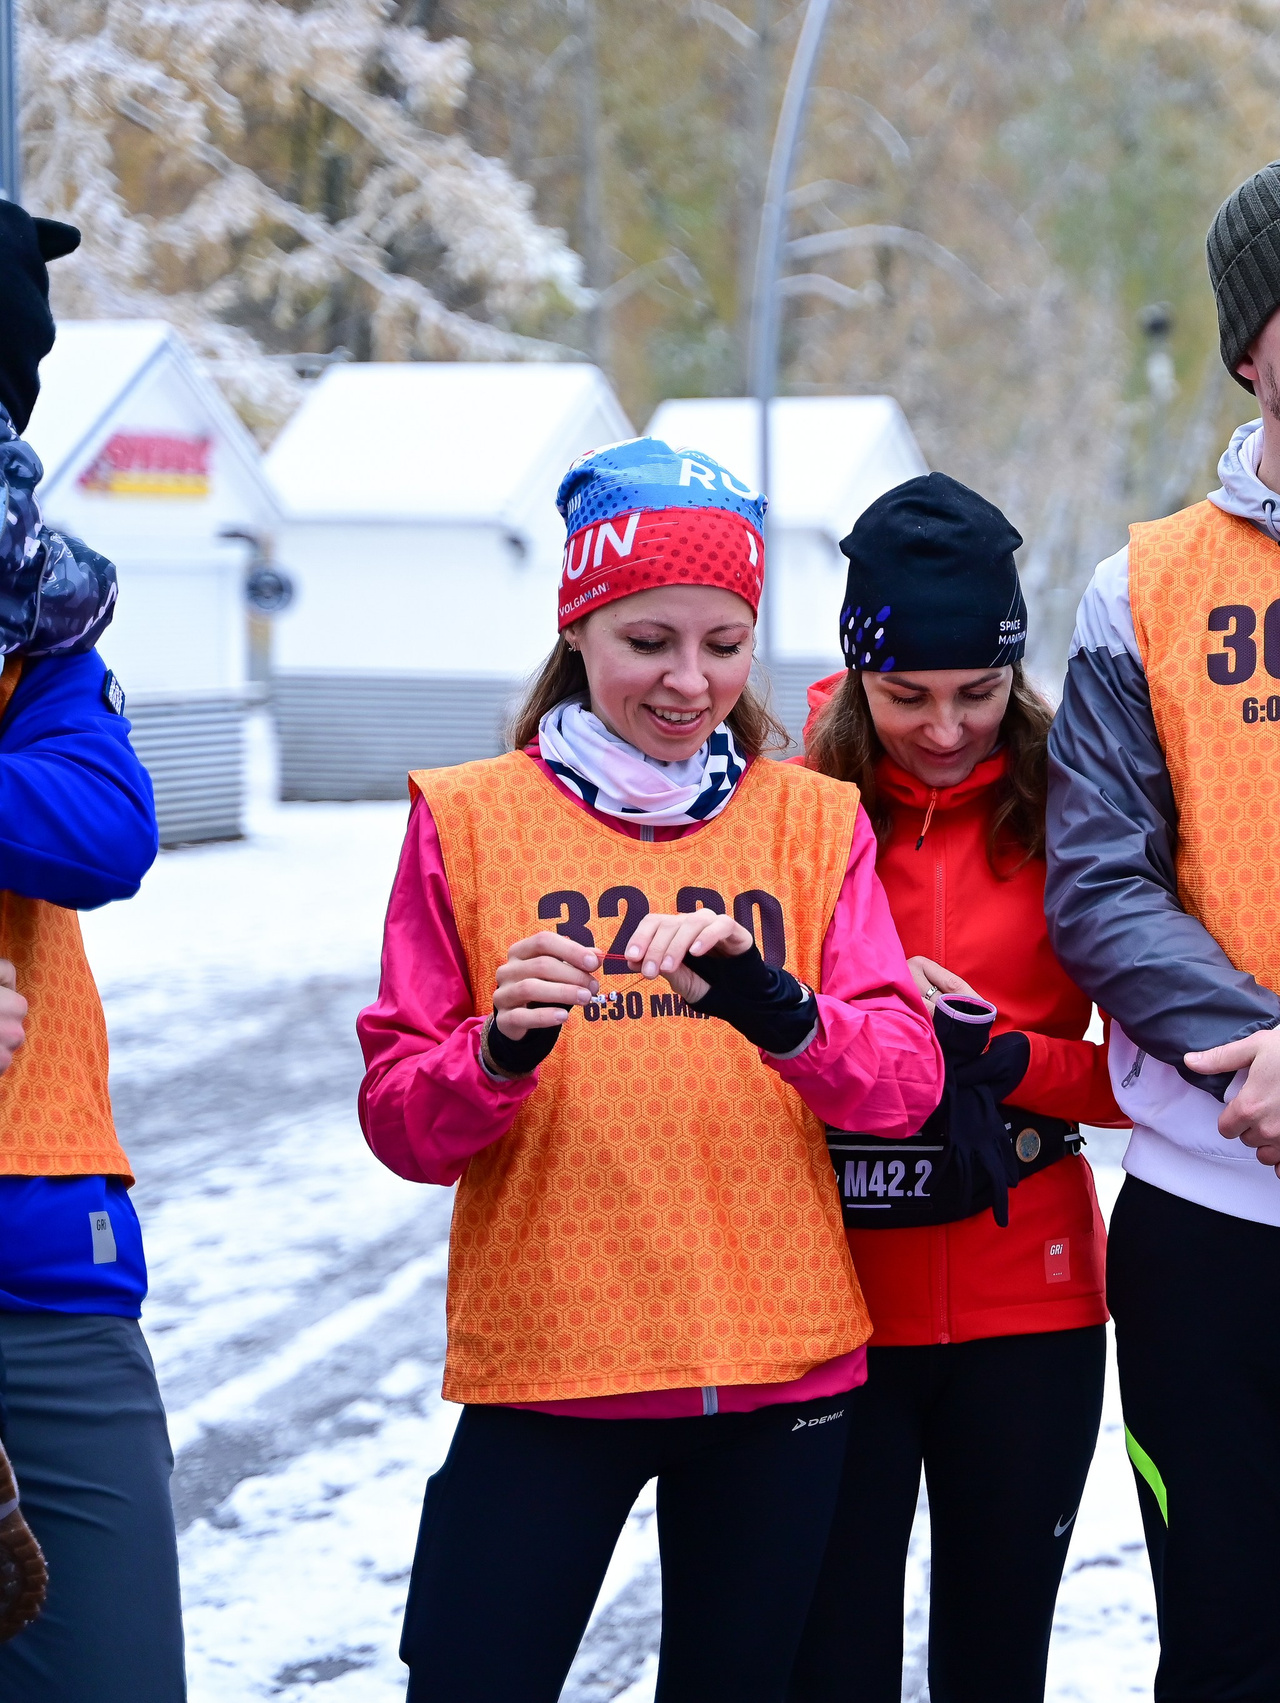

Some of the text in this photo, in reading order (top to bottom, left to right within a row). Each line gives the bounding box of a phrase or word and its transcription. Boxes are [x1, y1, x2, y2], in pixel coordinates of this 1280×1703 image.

[999, 619, 1021, 632] SPACE
[844, 1159, 933, 1198] M42.2
[807, 1409, 845, 1427] DEMIX
